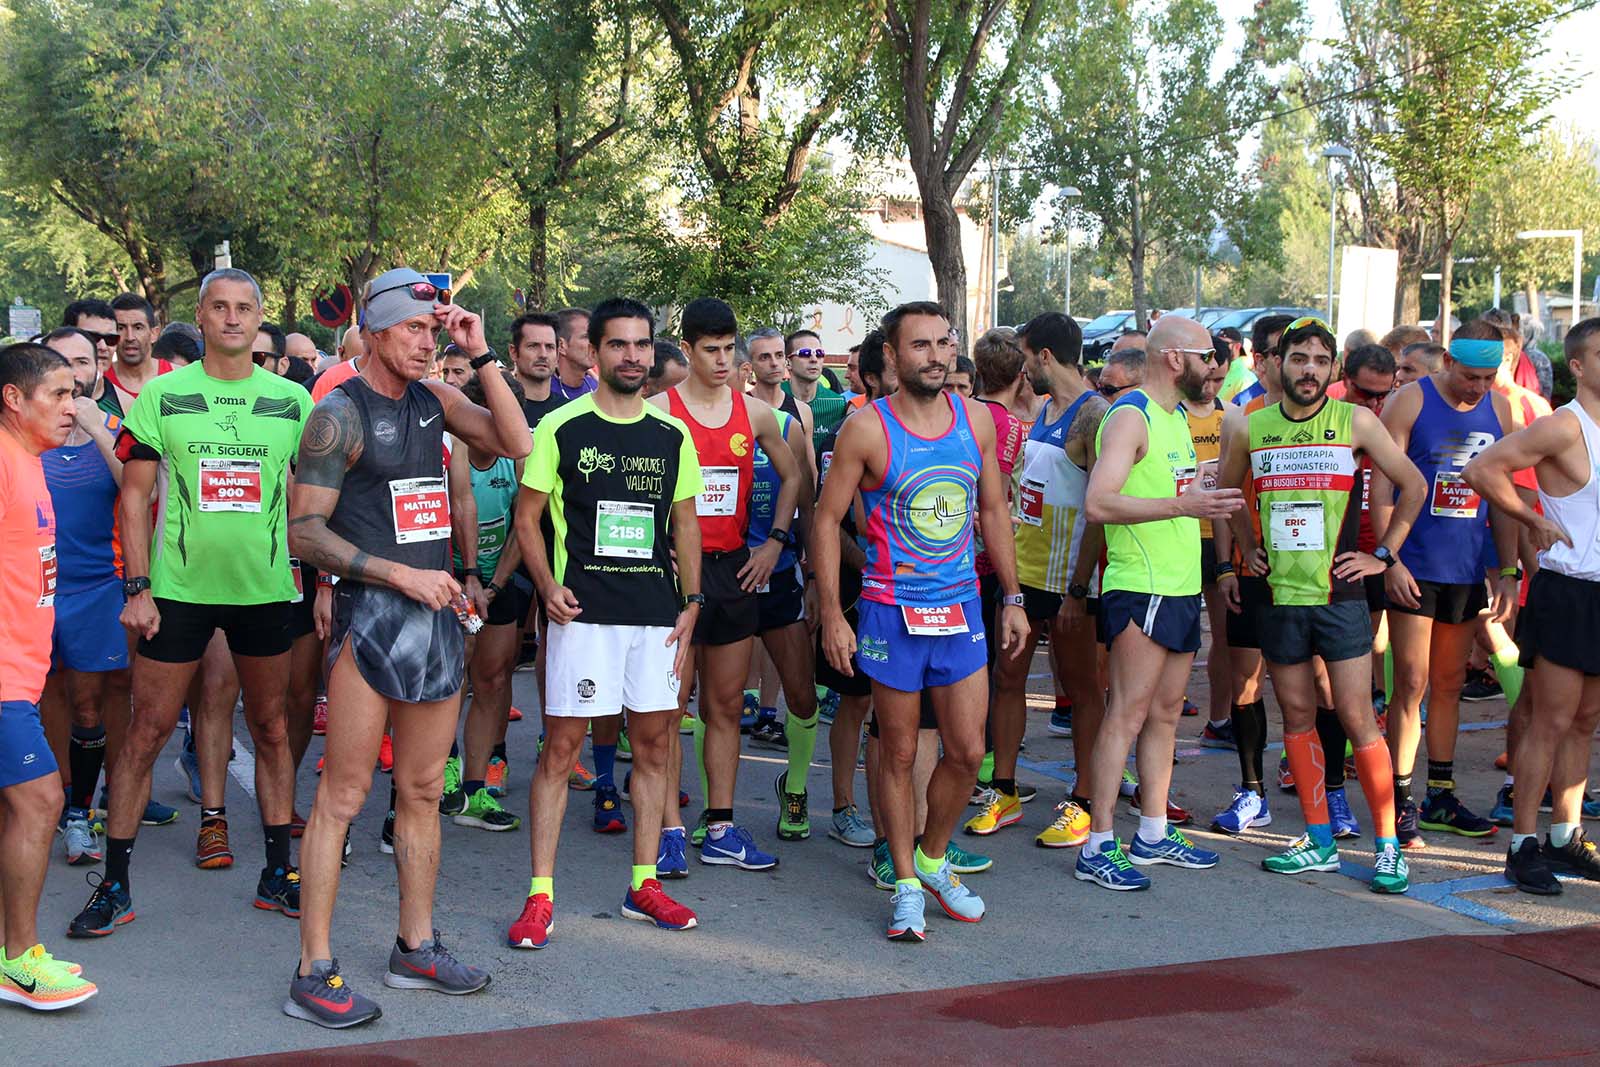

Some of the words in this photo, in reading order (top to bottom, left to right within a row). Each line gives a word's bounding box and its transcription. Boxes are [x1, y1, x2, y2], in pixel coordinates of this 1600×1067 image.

[213, 396, 247, 406] Joma
[187, 444, 214, 455] C.M.
[217, 446, 269, 457] SIGUEME
[1275, 450, 1334, 461] FISIOTERAPIA
[621, 455, 667, 475] SOMRIURES
[1275, 462, 1340, 472] E.MONASTERIO
[208, 477, 254, 487] MANUEL
[625, 475, 663, 494] VALENTS
[1273, 477, 1306, 488] BUSQUETS
[217, 487, 245, 498] 900
[1442, 487, 1474, 497] XAVIER
[702, 493, 725, 502] 1217
[1449, 496, 1467, 506] 714
[403, 500, 442, 512] MATTIAS
[414, 512, 438, 525] 454
[1284, 518, 1307, 527] ERIC
[608, 525, 645, 540] 2158
[1291, 528, 1300, 538] 5
[913, 606, 952, 615] OSCAR
[922, 615, 947, 625] 583
